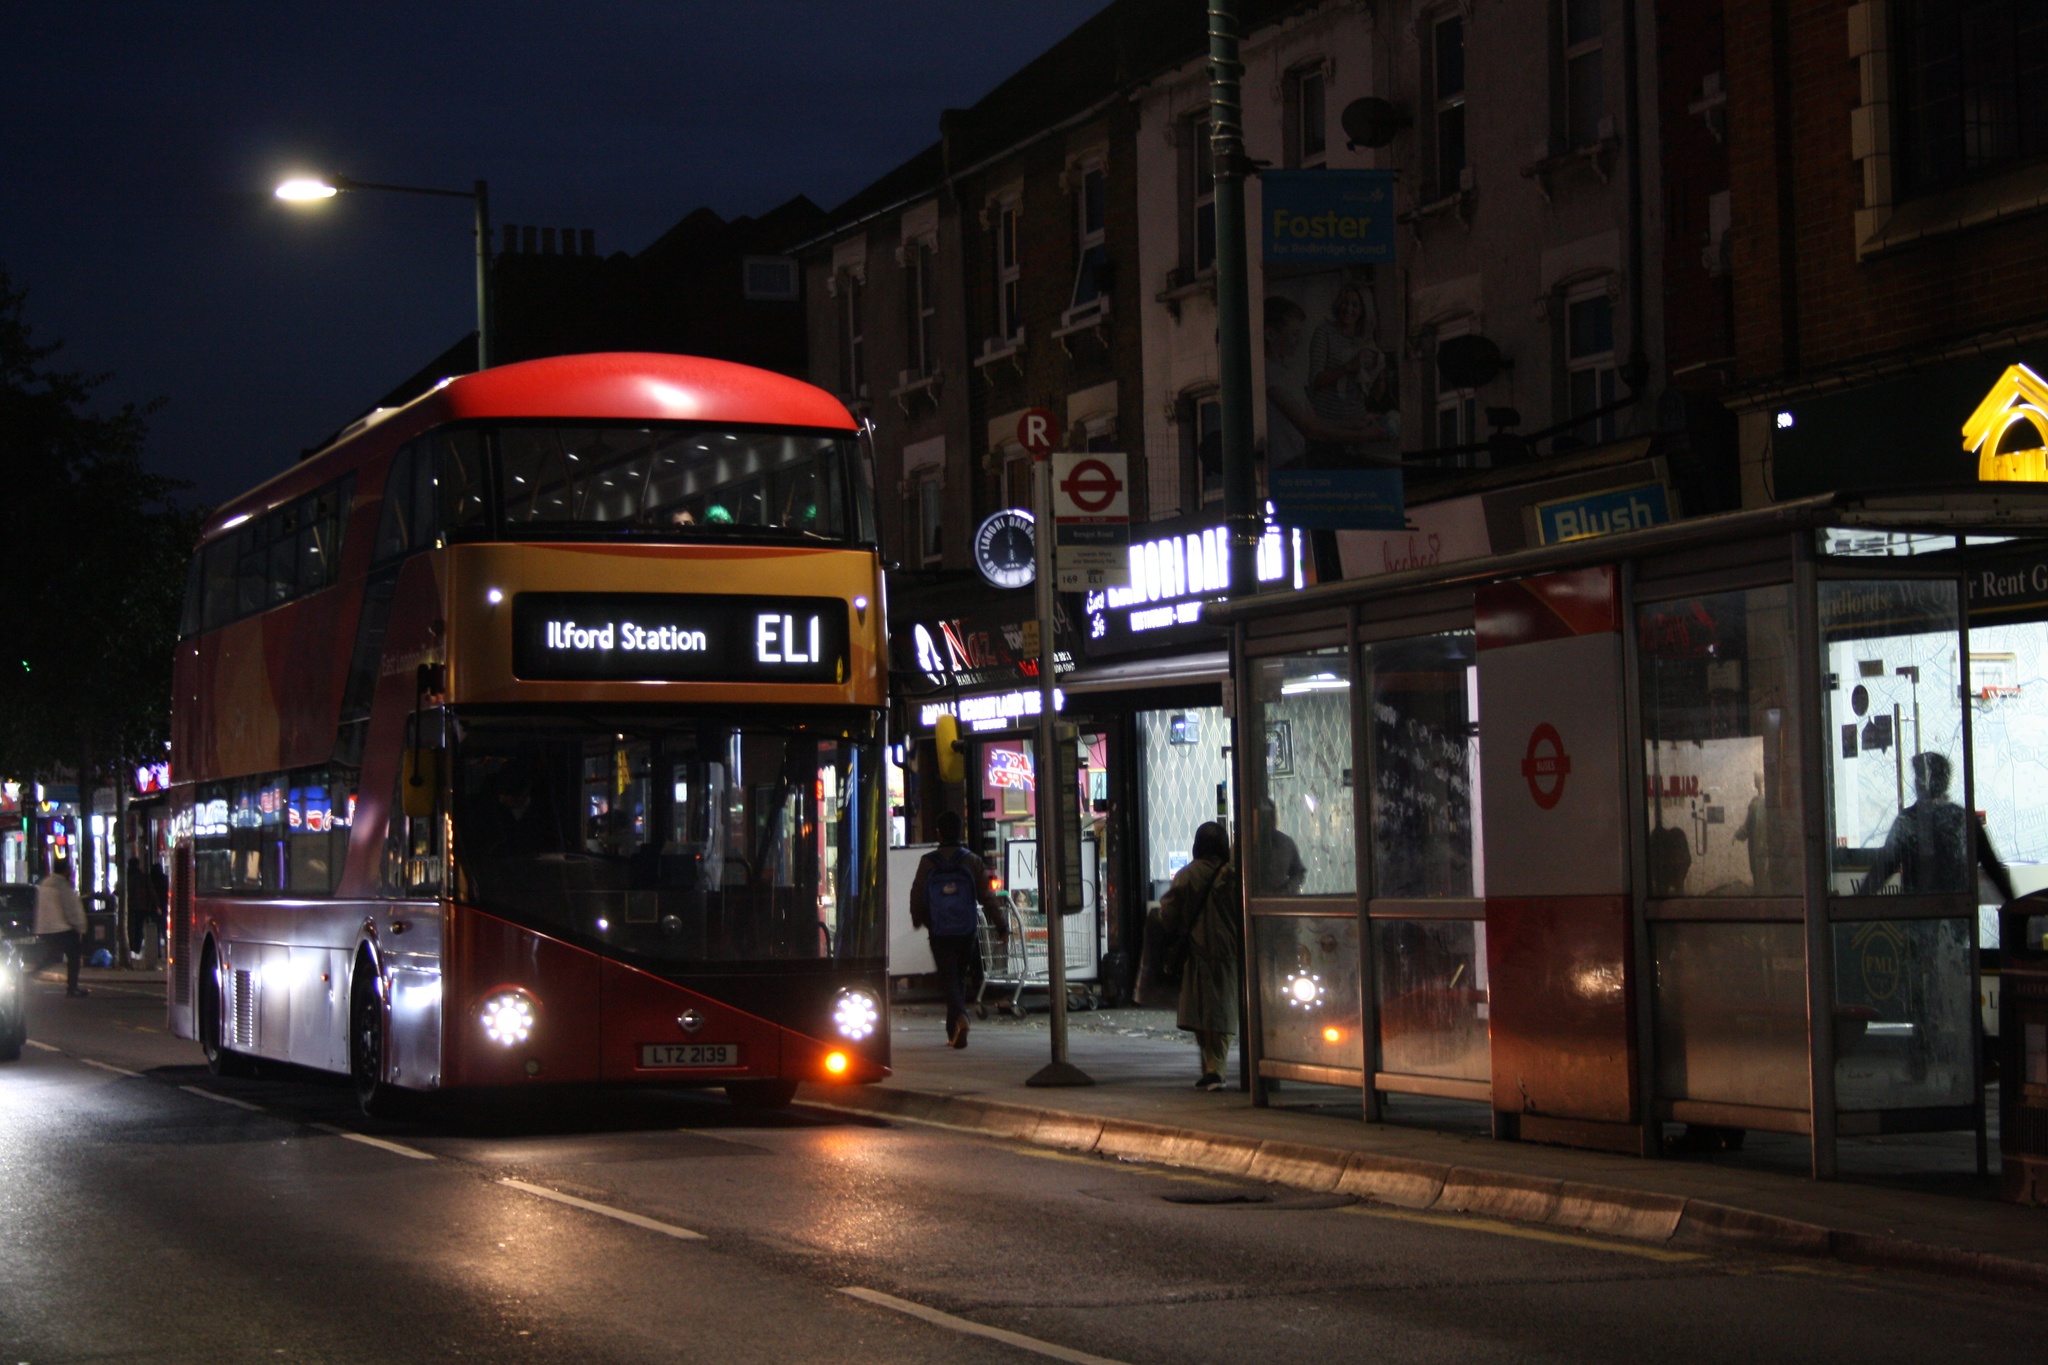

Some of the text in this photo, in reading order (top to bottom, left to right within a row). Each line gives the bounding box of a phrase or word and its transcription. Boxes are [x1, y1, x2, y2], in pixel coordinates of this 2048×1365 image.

[1273, 208, 1372, 239] Foster
[1348, 243, 1387, 254] Council
[1027, 415, 1050, 447] R
[1554, 496, 1653, 540] Blush
[980, 517, 1006, 550] LAHORI
[1097, 531, 1114, 539] Road
[1062, 575, 1078, 584] 169
[1982, 570, 2027, 598] Rent
[547, 621, 707, 651] Ilford Station
[756, 613, 820, 663] EL1
[938, 619, 999, 673] Naz
[956, 673, 972, 687] HAIR
[1536, 760, 1555, 772] BUSES
[652, 1046, 727, 1063] LTZ 2139
